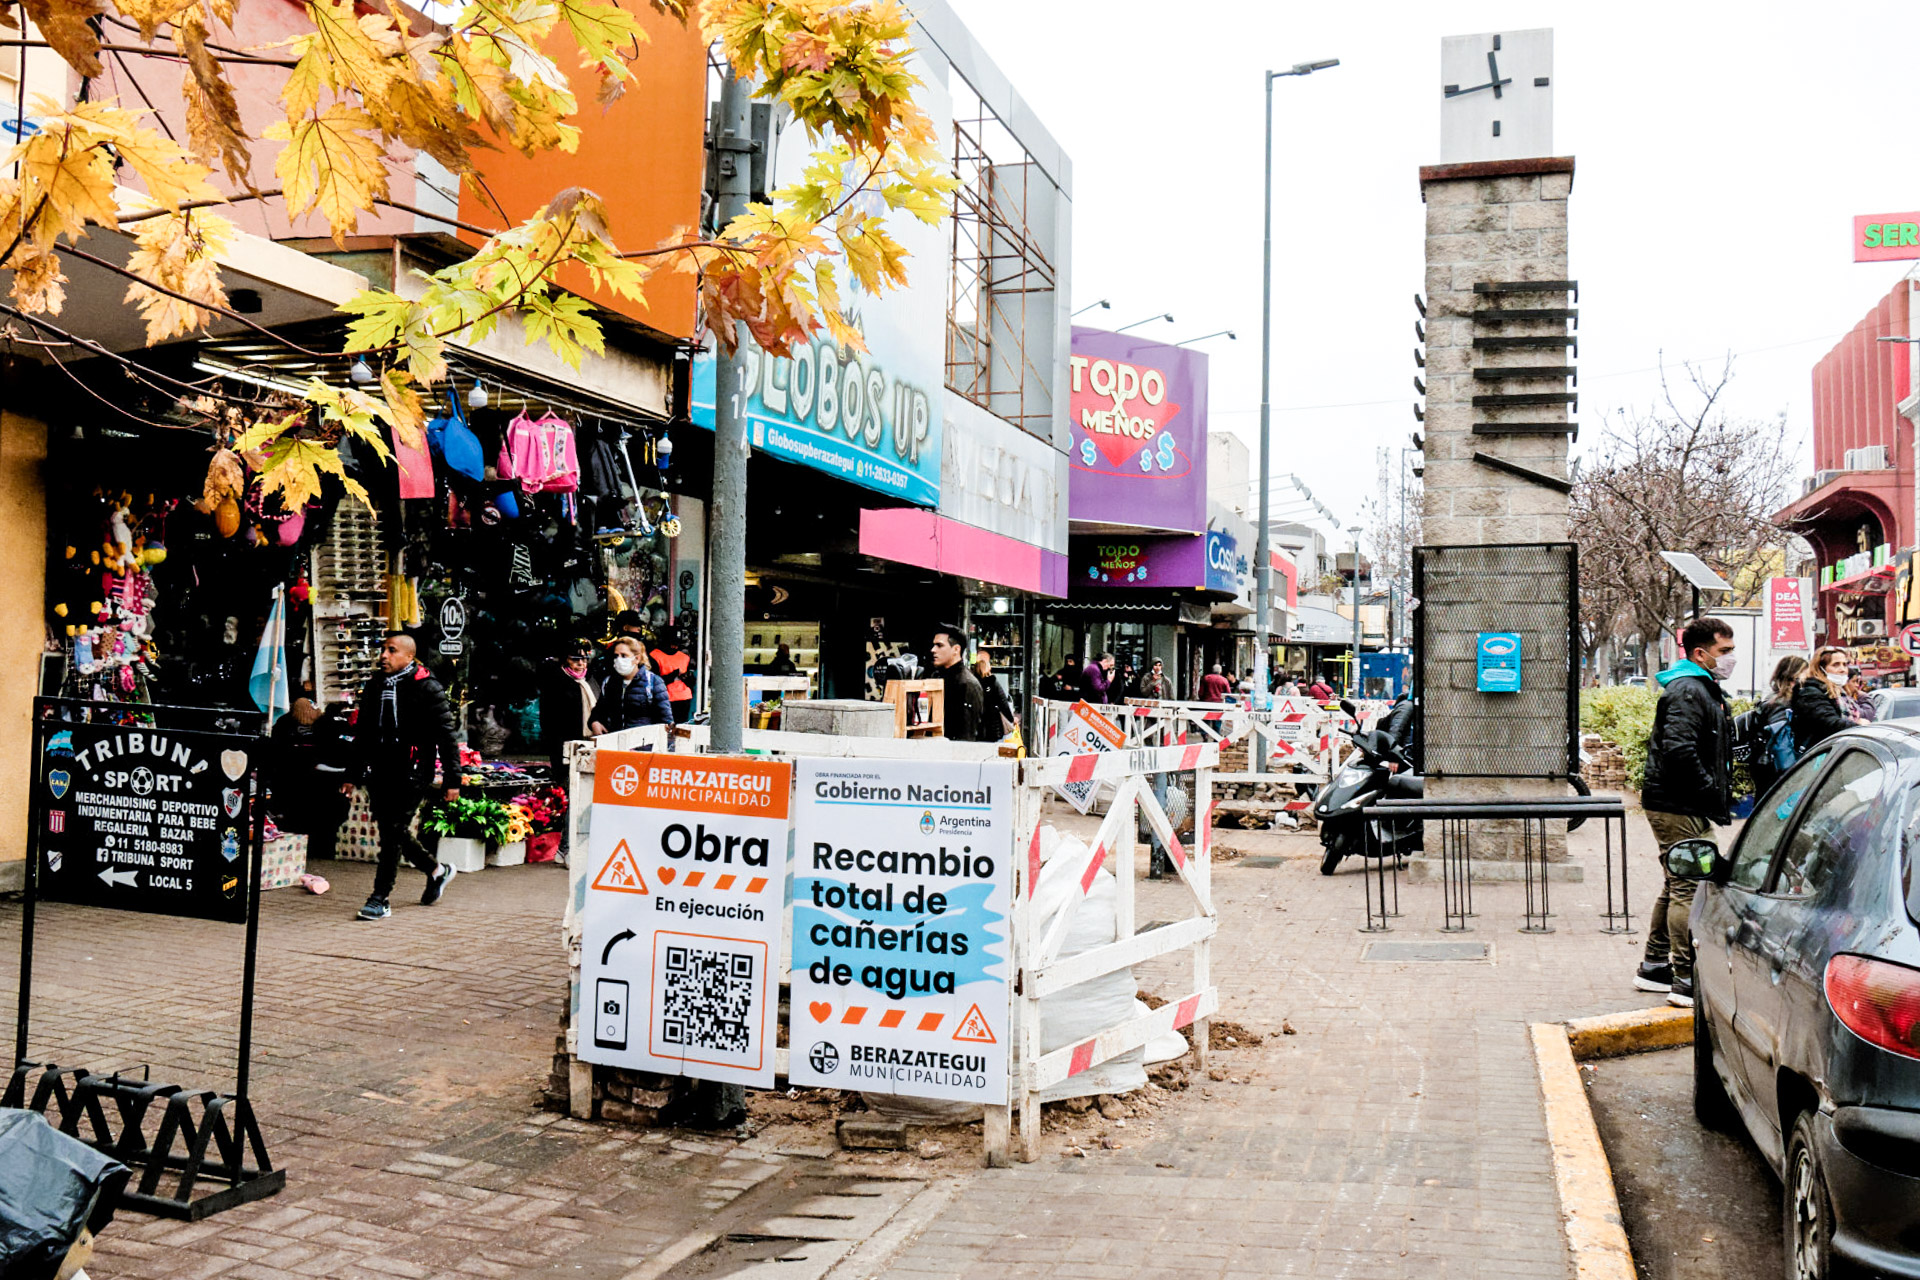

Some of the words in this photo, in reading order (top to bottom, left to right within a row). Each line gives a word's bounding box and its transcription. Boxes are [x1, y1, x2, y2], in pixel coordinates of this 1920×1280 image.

[1863, 222, 1920, 248] SER
[1070, 356, 1165, 406] TODO
[894, 382, 930, 466] UP
[1081, 408, 1156, 440] MENOS
[1097, 545, 1140, 557] TODO
[1101, 561, 1136, 569] MENOS
[1775, 592, 1800, 601] DEA
[443, 605, 463, 625] 10%
[648, 767, 772, 792] BERAZATEGUI
[75, 791, 157, 811] MERCHANDISING
[162, 800, 219, 817] DEPORTIVO
[646, 786, 771, 807] MUNICIPALIDAD
[815, 781, 902, 801] Gobierno
[907, 784, 992, 805] Nacional
[78, 804, 152, 823] INDUMENTARIA
[157, 813, 185, 827] PARA
[190, 816, 216, 830] BEBE
[939, 815, 992, 829] Argentina
[94, 820, 149, 837] REGALERIA
[160, 826, 194, 842] BAZAR
[939, 828, 973, 836] Presidencia
[117, 837, 128, 849] 11
[134, 839, 184, 856] 5180-8983
[661, 823, 769, 868] Obra
[111, 850, 155, 867] TRIBUNA
[160, 855, 194, 871] SPORT
[813, 841, 995, 879] Recambio
[149, 874, 183, 890] LOCAL
[186, 879, 193, 891] 5
[655, 896, 675, 912] En
[679, 898, 764, 922] ejecución
[811, 881, 894, 912] total
[903, 884, 947, 915] de
[809, 919, 969, 956] cañerías
[809, 956, 853, 986] de
[861, 964, 956, 1000] agua
[850, 1045, 986, 1073] BERAZATEGUI
[849, 1063, 986, 1089] MUNICIPALIDAD
